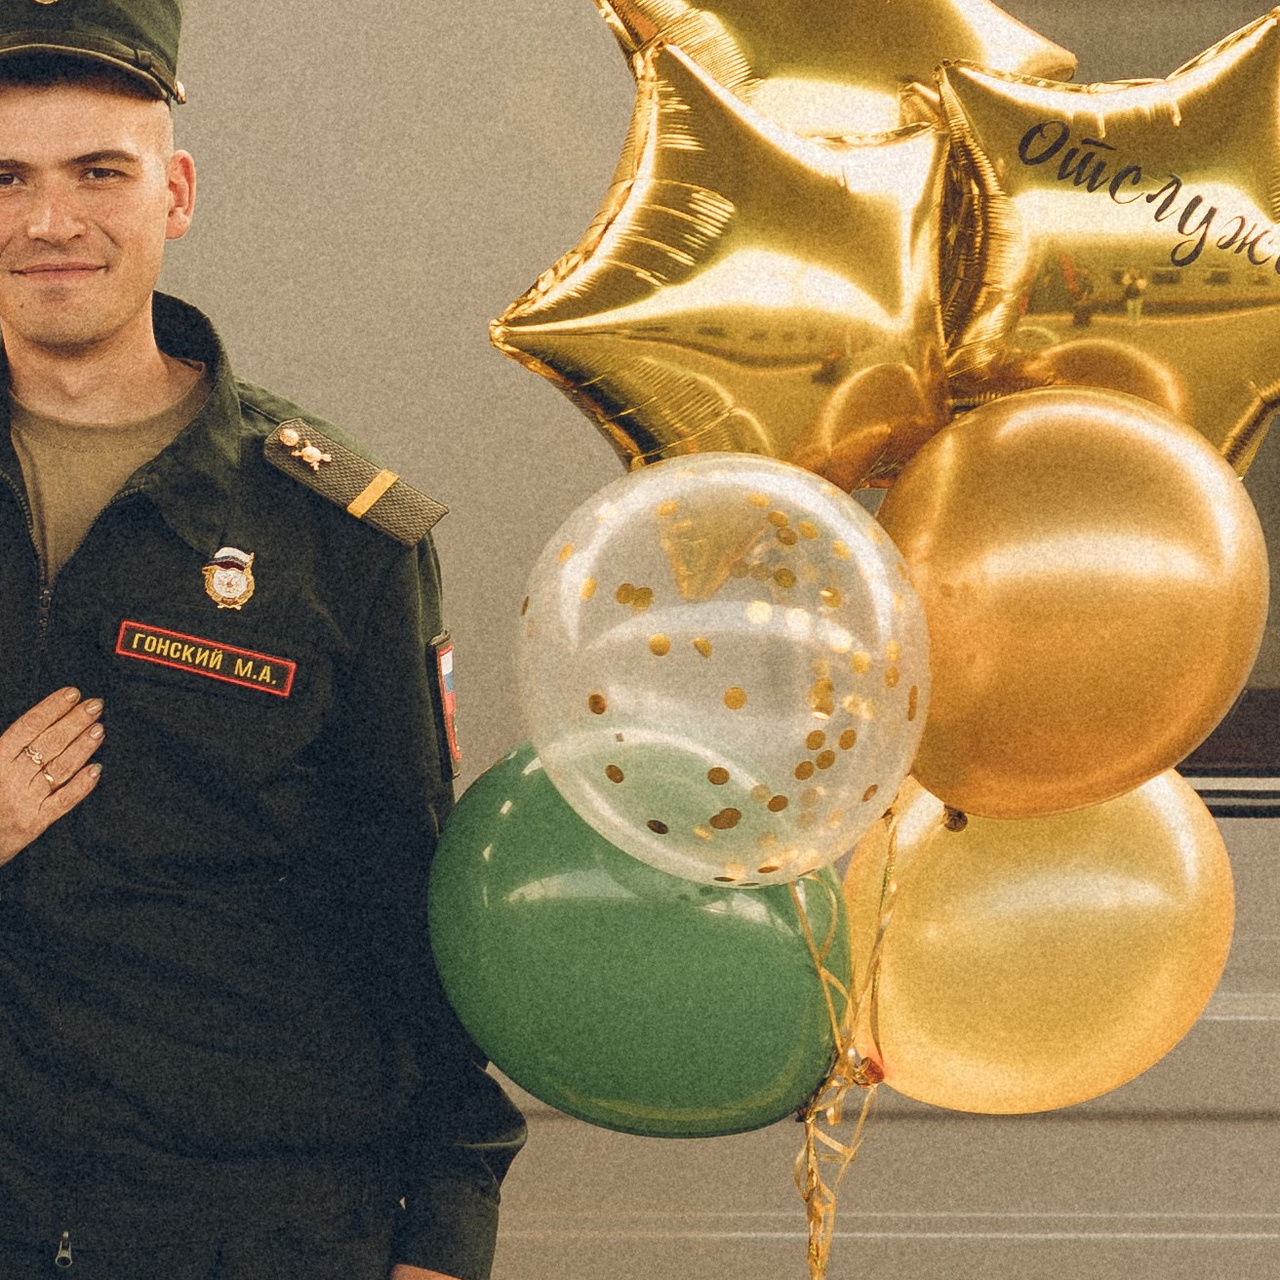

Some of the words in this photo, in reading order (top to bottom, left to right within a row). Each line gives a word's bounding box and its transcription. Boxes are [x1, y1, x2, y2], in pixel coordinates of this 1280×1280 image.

[1018, 120, 1280, 276] Отслуж
[132, 632, 224, 671] ГОНСКИЙ
[233, 658, 278, 685] М.А.
